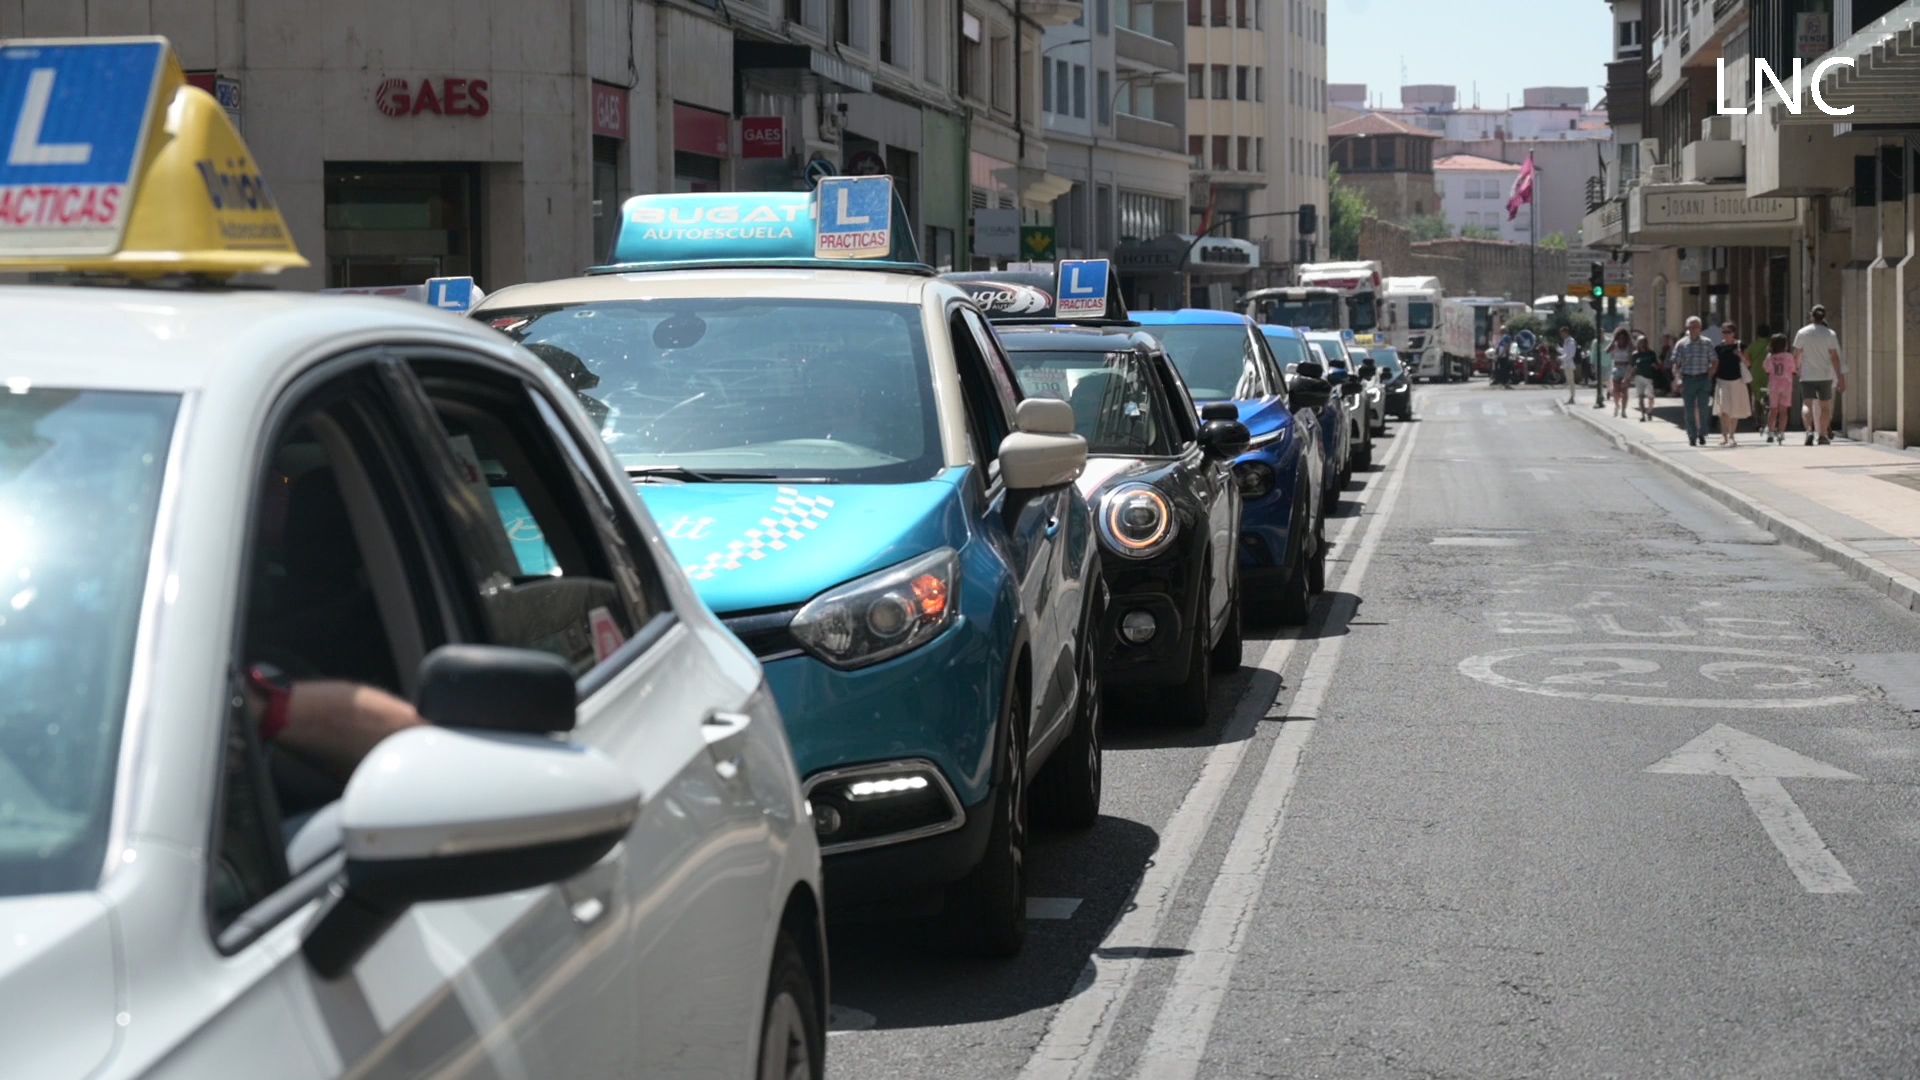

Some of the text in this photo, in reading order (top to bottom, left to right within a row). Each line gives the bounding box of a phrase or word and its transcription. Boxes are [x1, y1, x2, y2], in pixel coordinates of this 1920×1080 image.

[375, 78, 489, 118] GAES
[6, 67, 93, 166] L
[743, 127, 781, 142] GAES
[0, 187, 120, 225] ACTICAS
[836, 188, 870, 226] L
[642, 227, 794, 241] AUTOESCUELA
[820, 231, 886, 249] PRACTICAS
[1122, 254, 1172, 265] HOTEL
[1070, 267, 1094, 294] L
[438, 284, 461, 307] L
[1059, 299, 1104, 310] PRACTICAS
[1772, 362, 1785, 377] 10
